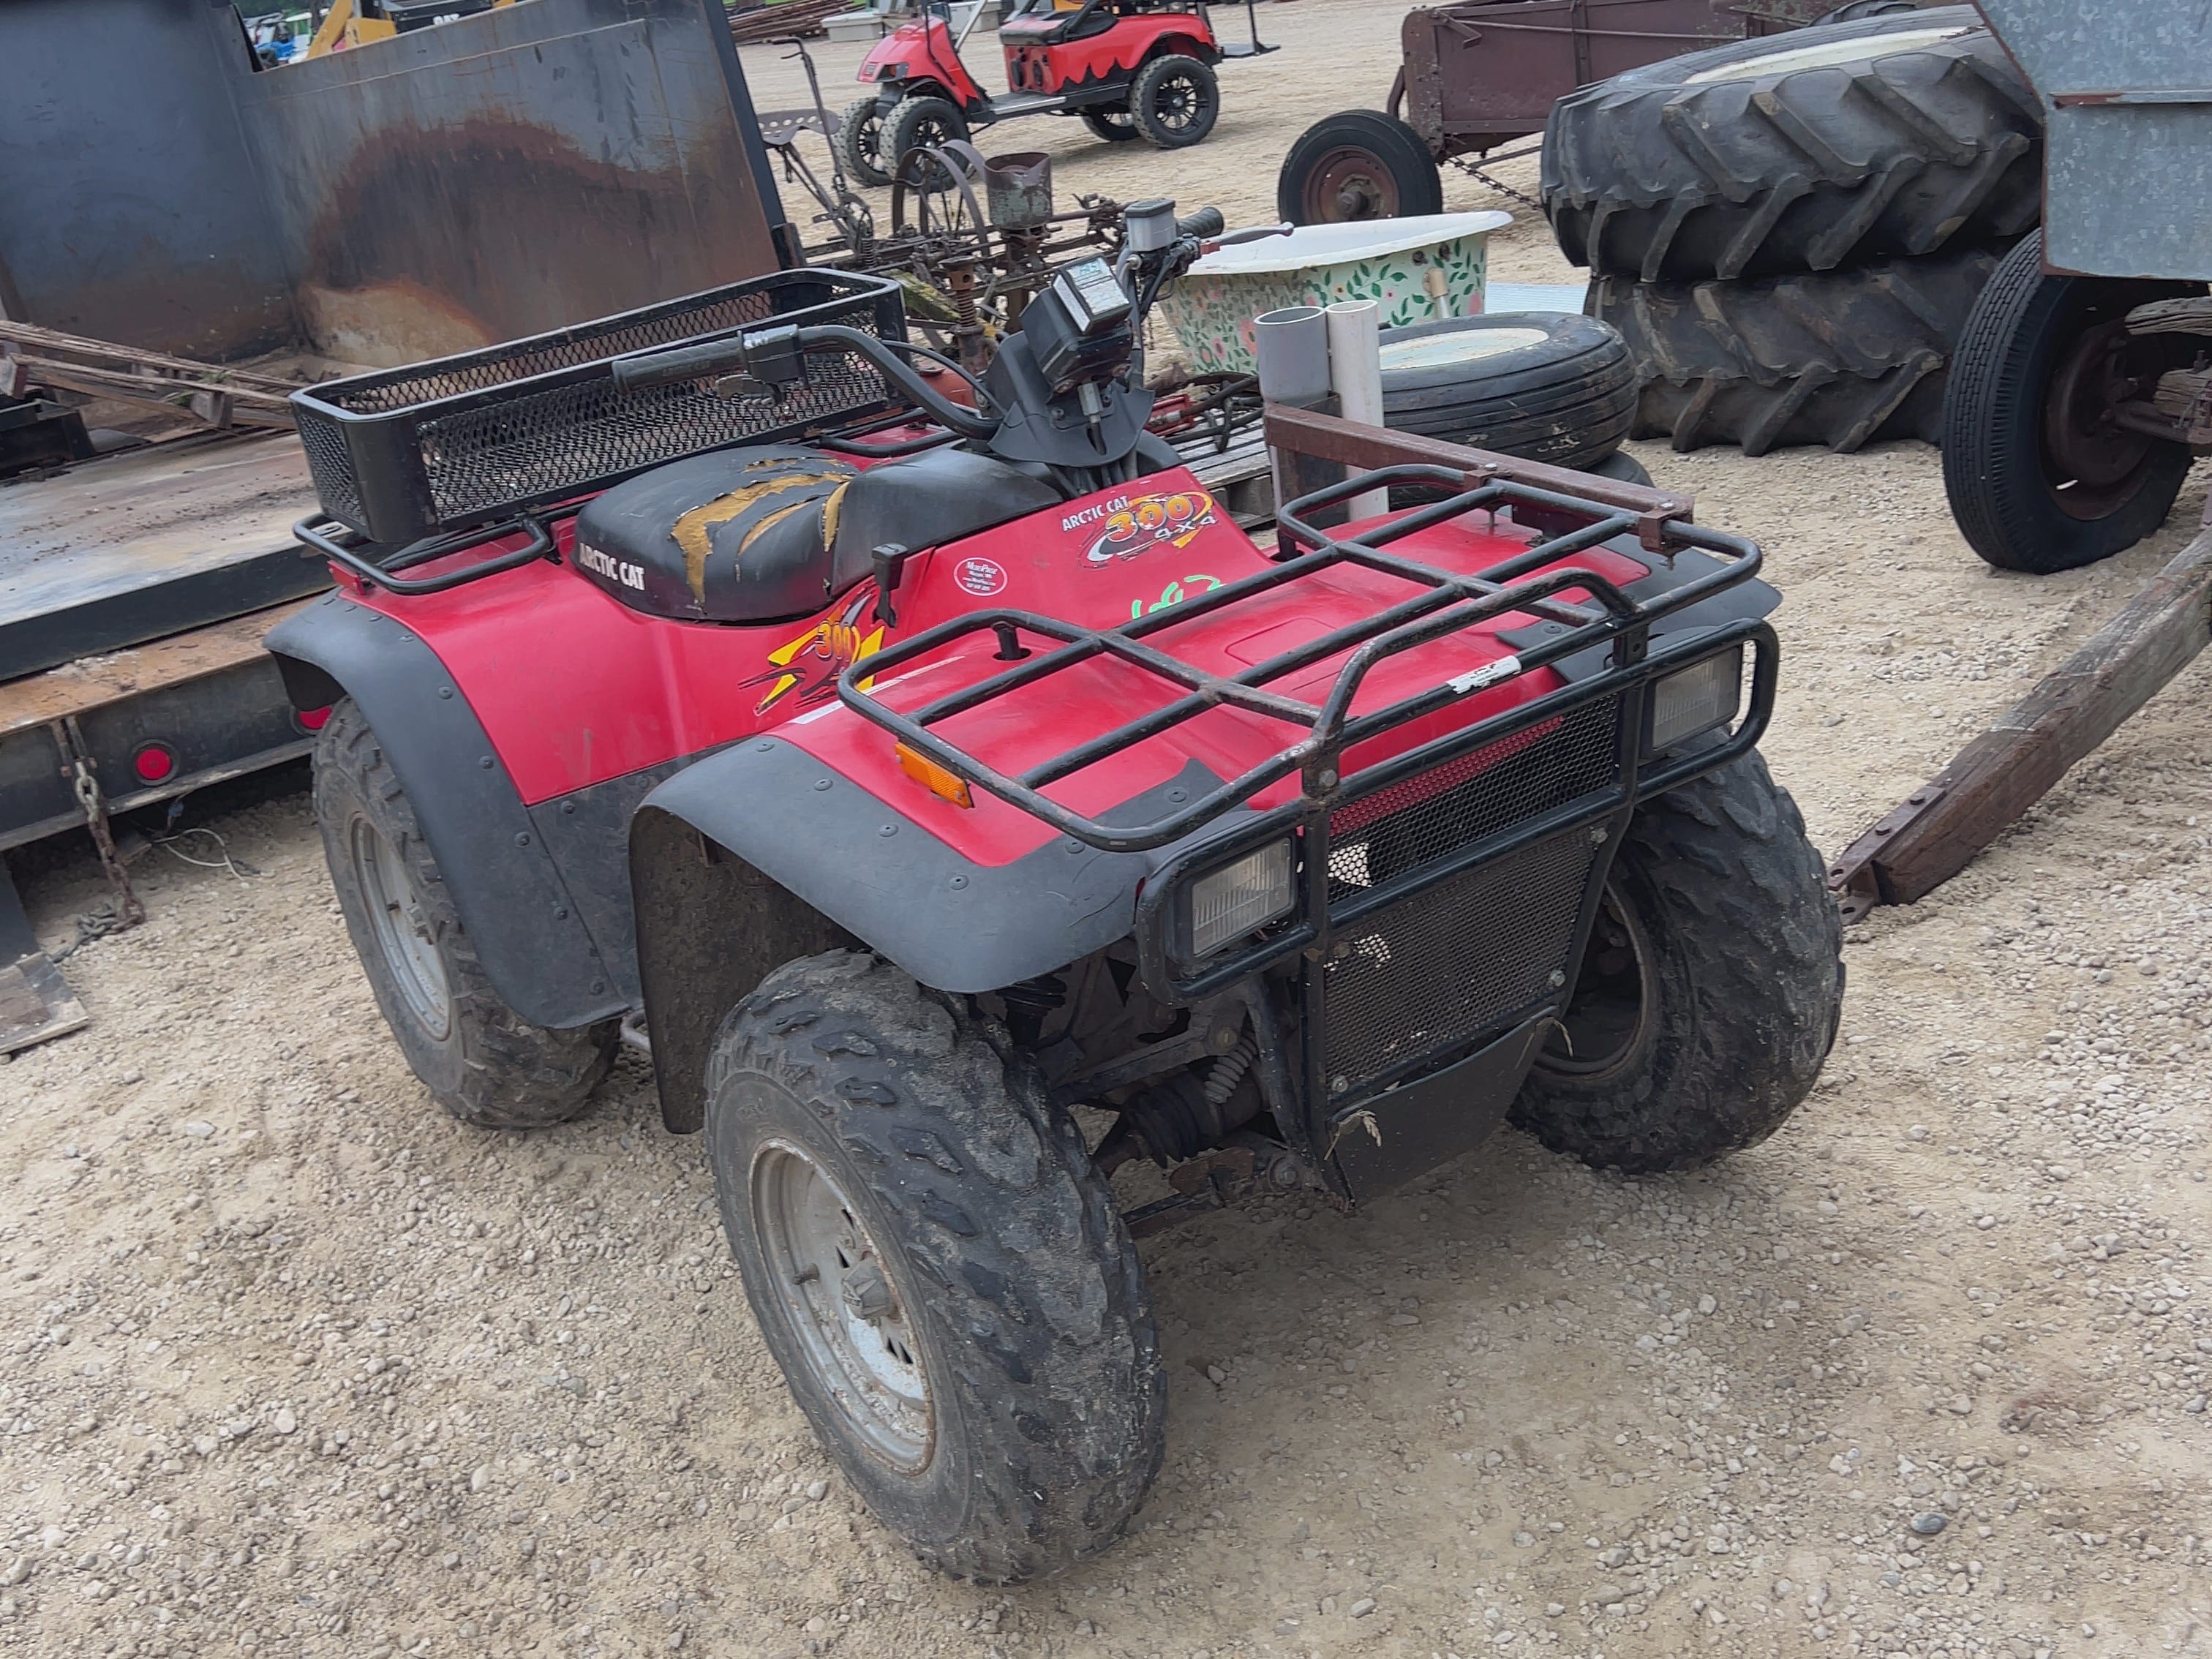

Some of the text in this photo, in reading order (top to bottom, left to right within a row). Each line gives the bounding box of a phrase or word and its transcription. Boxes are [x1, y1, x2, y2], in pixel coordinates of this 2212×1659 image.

[1061, 495, 1130, 532] ARCTIC CAT
[1105, 493, 1195, 543] 300
[579, 542, 645, 591] ARCTIC CAT
